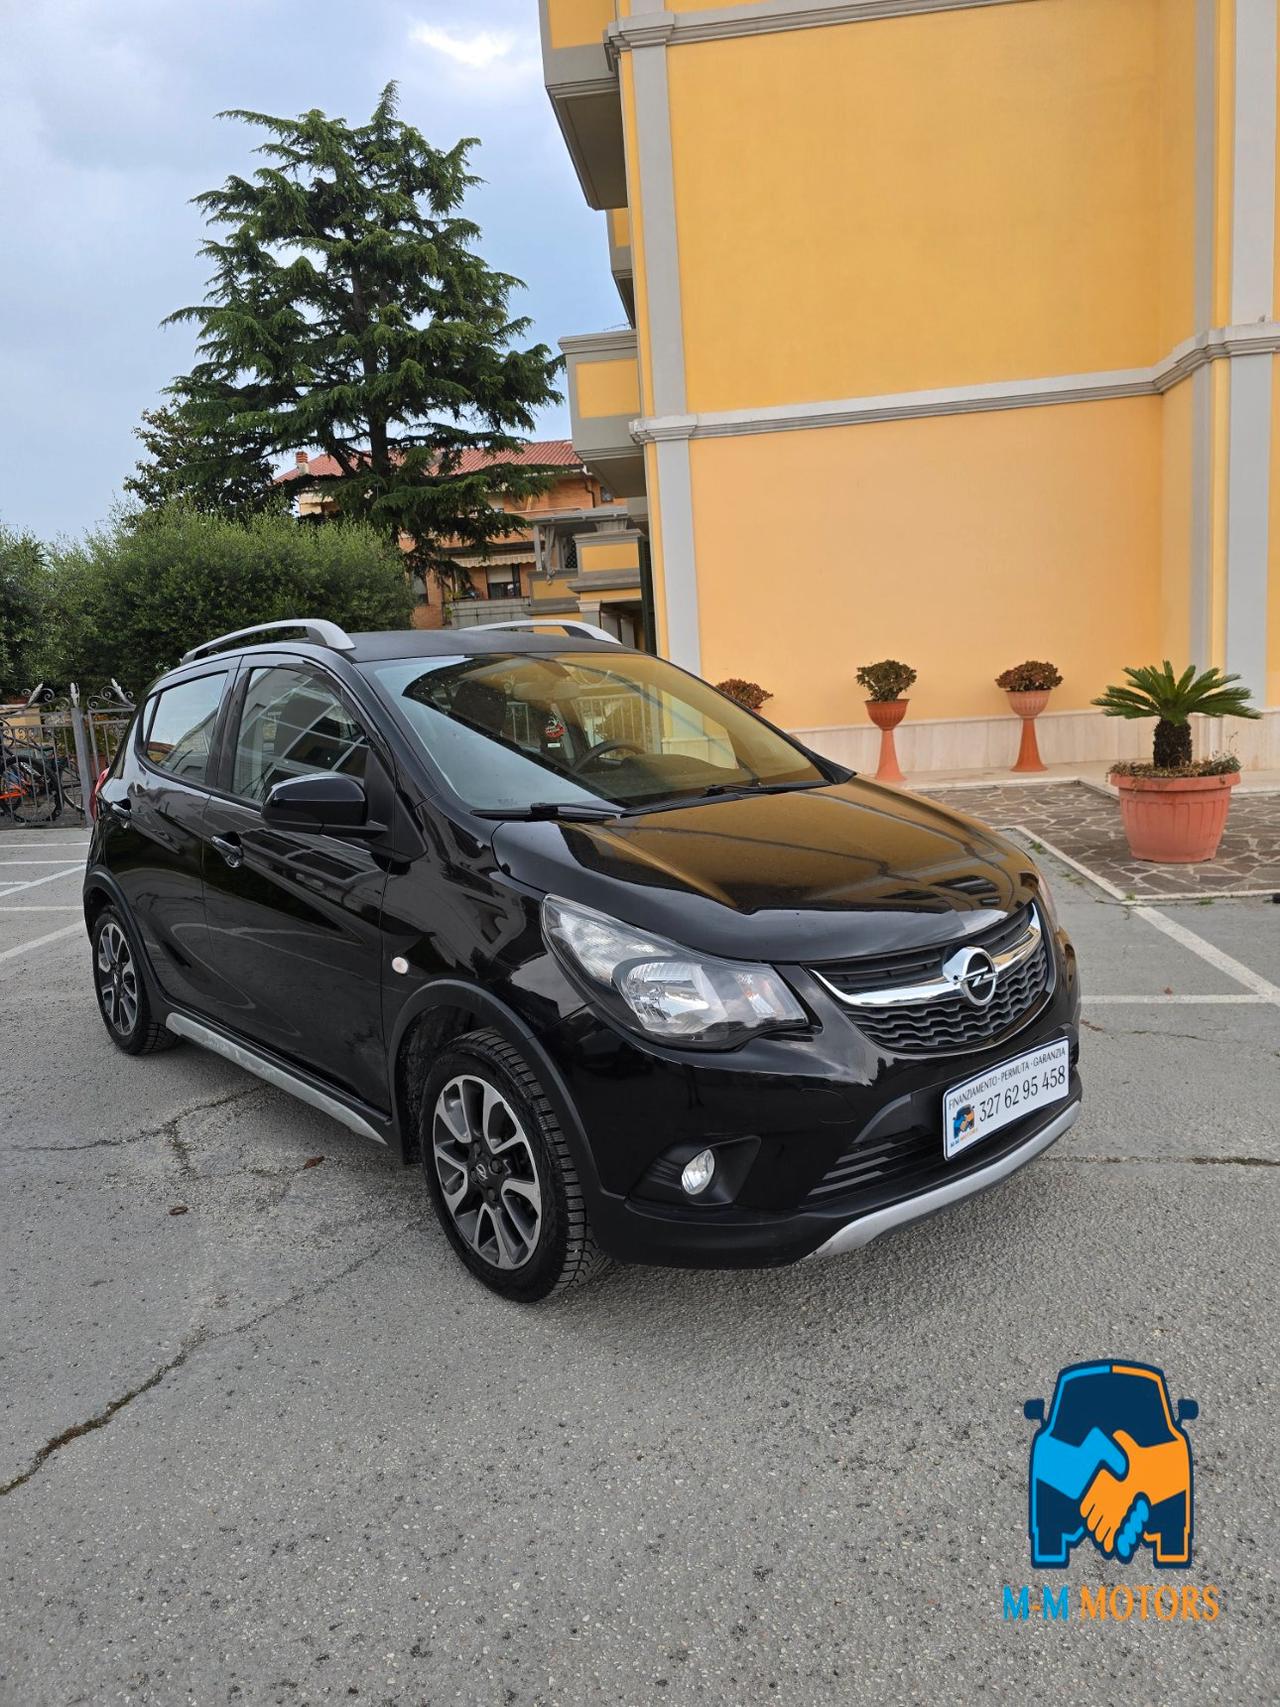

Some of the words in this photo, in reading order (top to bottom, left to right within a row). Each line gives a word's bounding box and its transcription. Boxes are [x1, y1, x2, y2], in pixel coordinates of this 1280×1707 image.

[979, 1093, 1001, 1122] 327
[1005, 1084, 1019, 1109] 62
[1022, 1075, 1038, 1100] 95
[1042, 1065, 1066, 1091] 458
